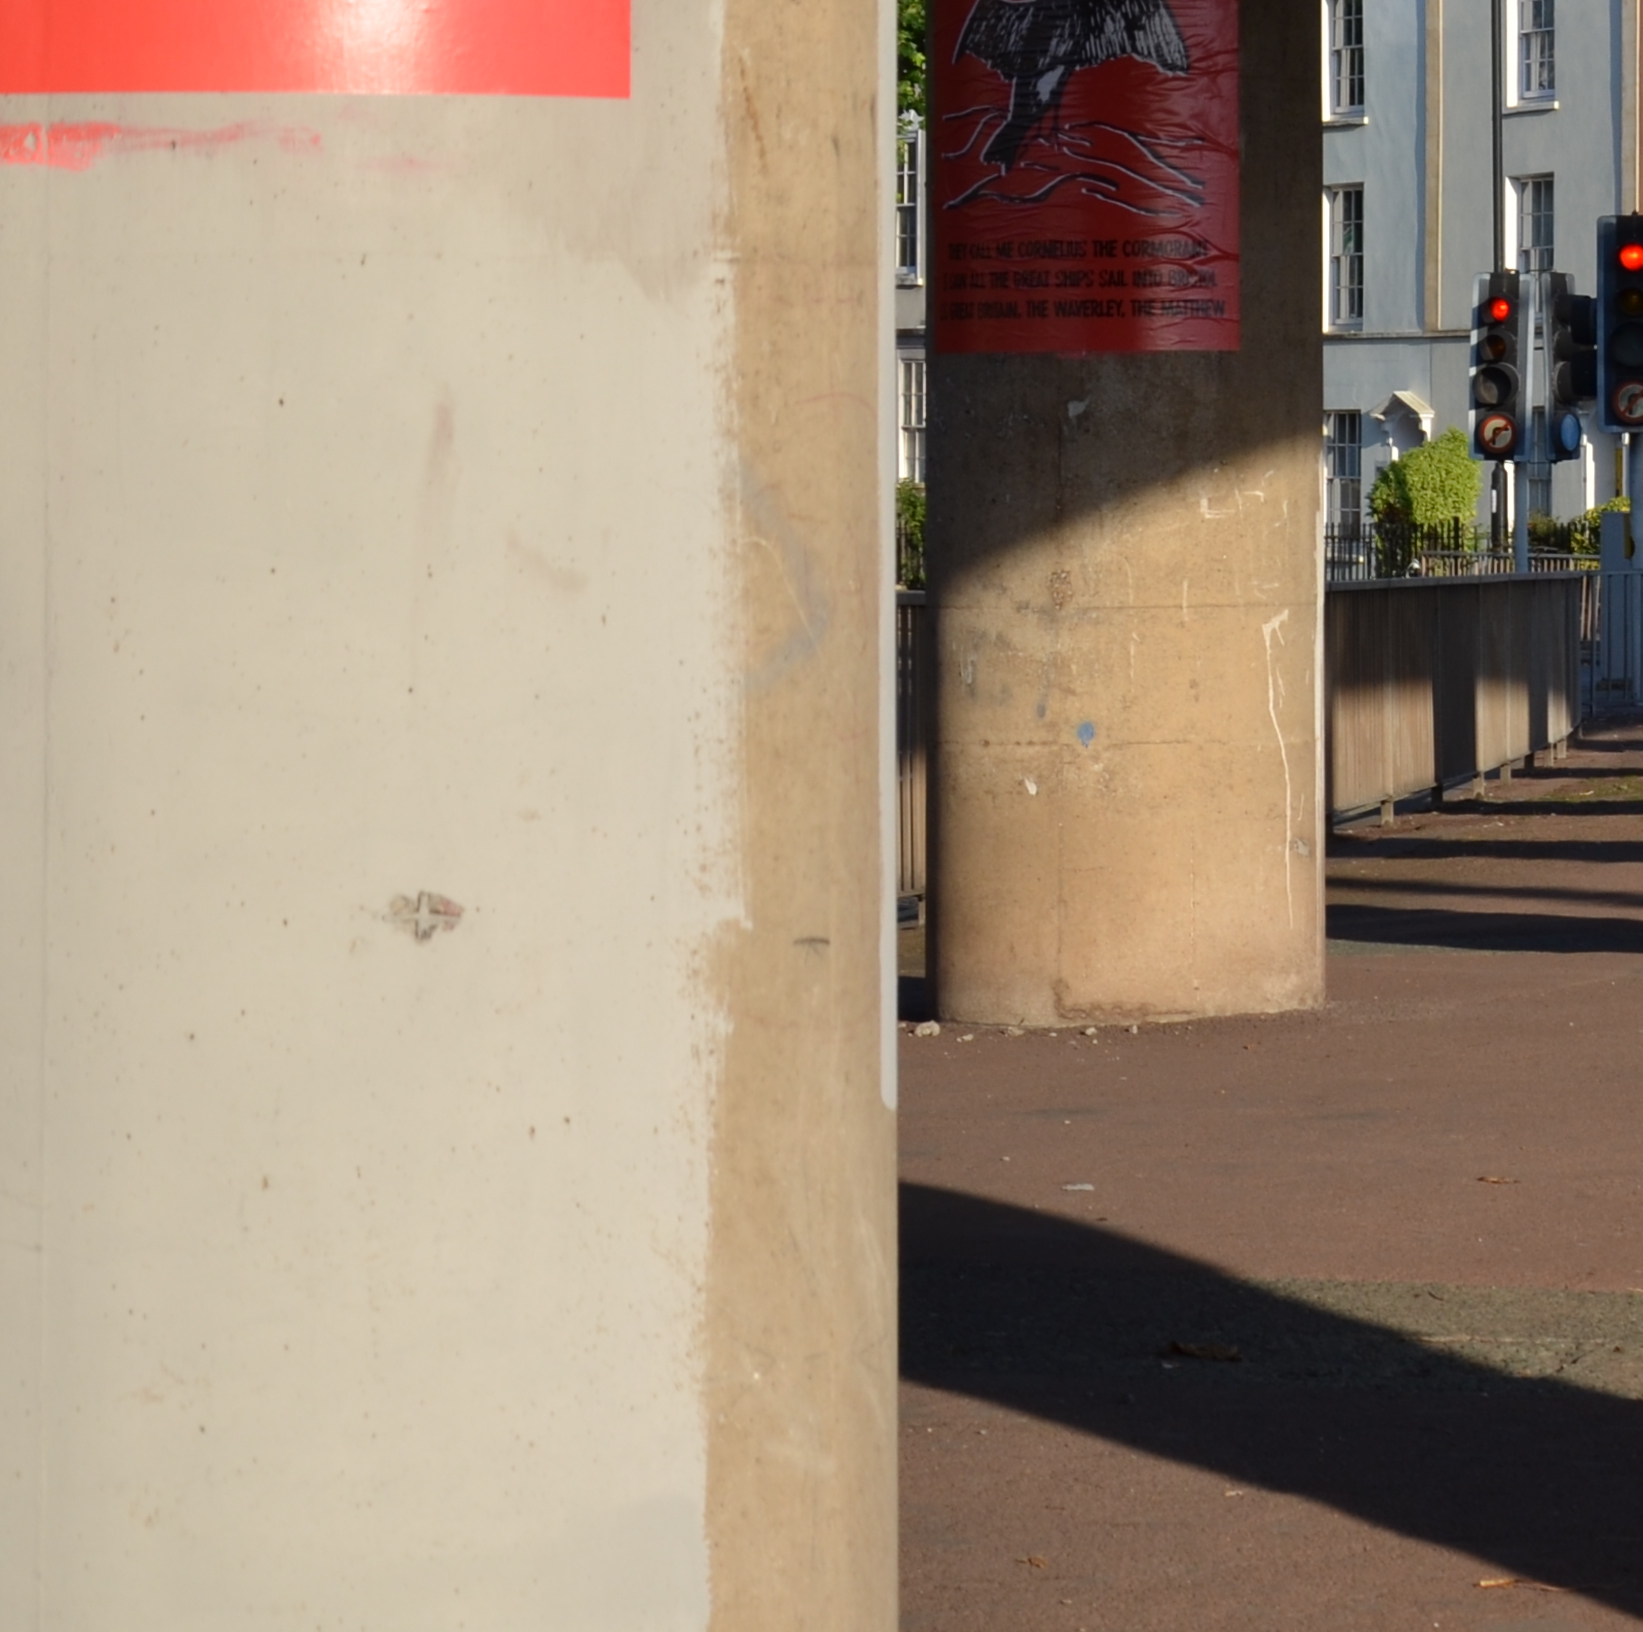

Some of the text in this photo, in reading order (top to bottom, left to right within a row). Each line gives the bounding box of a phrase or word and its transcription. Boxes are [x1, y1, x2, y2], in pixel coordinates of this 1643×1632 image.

[1092, 240, 1118, 258] THE
[990, 271, 1009, 289] THE
[1013, 270, 1051, 289] GREAT
[1054, 269, 1094, 289] SHIPS
[1099, 269, 1128, 288] SAIL
[1132, 269, 1162, 288] INTO
[1168, 269, 1217, 288] BRITOL
[1026, 300, 1049, 318] THE
[1054, 299, 1125, 318] WAVERLEY,
